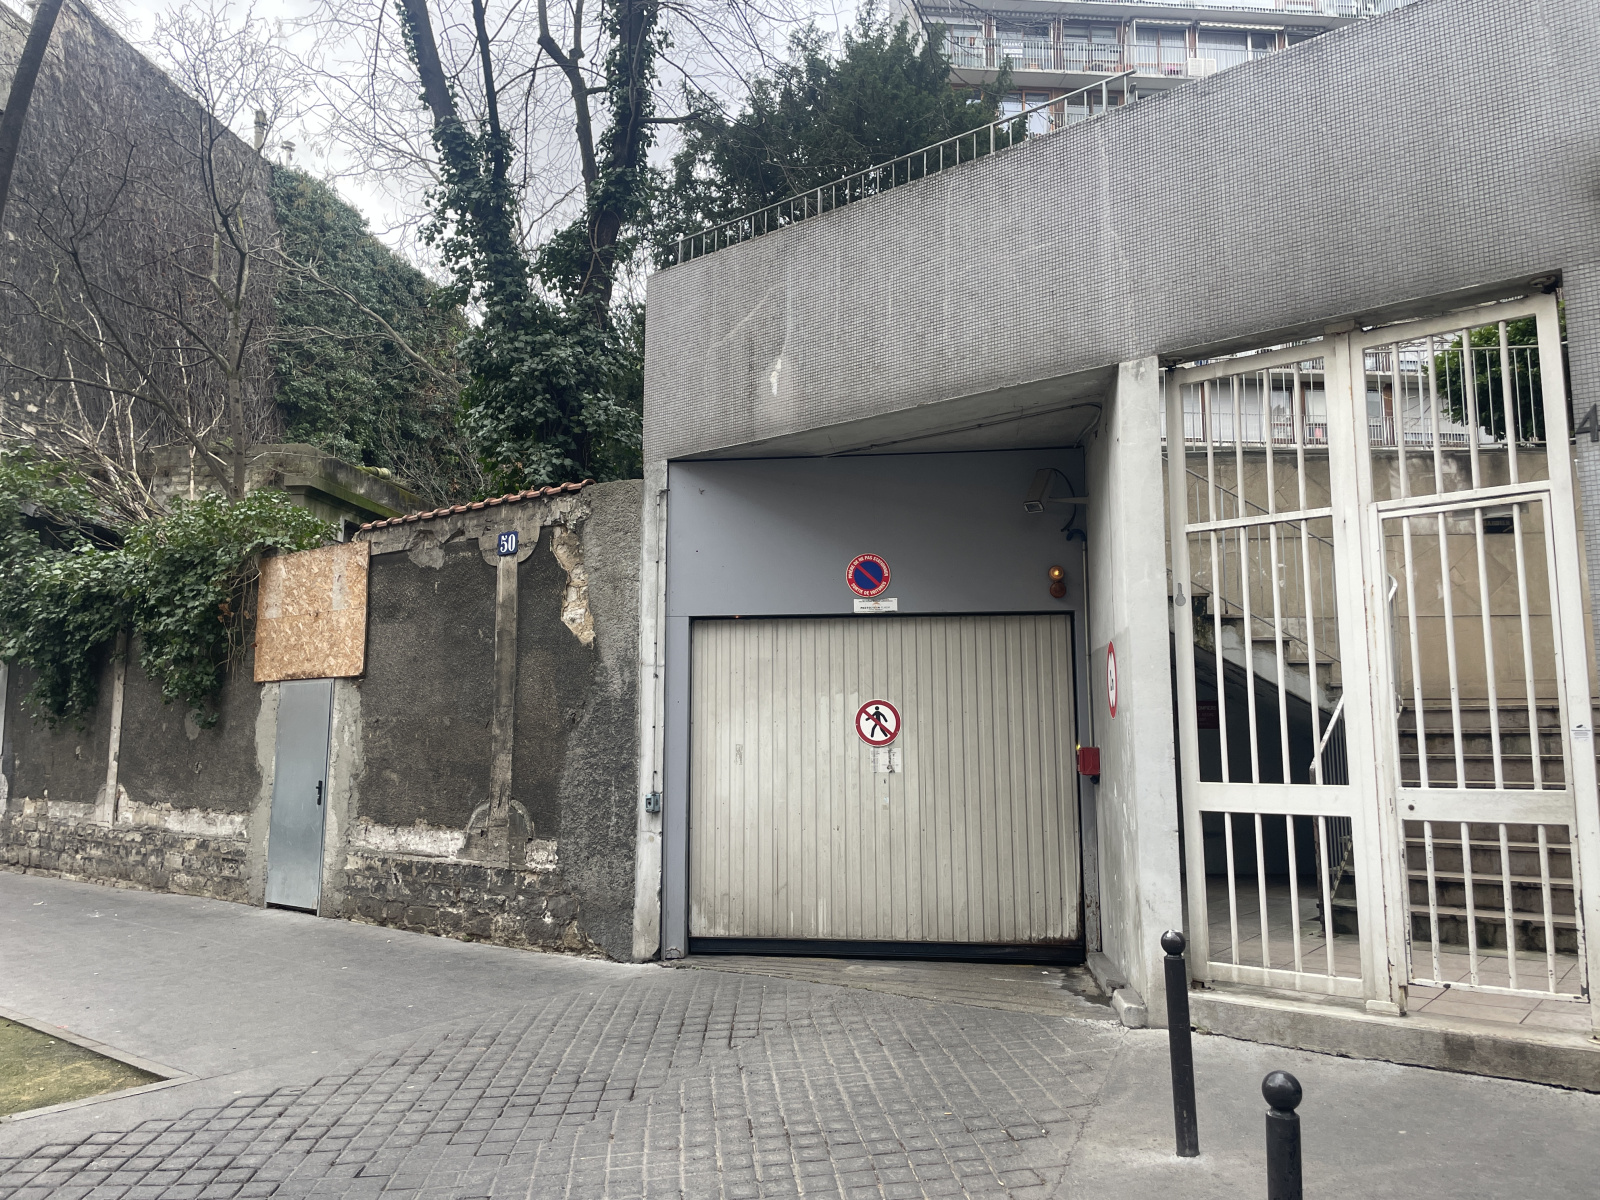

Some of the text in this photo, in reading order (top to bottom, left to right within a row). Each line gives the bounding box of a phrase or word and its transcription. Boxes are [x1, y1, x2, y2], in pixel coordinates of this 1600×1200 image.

[500, 534, 516, 552] 50
[873, 556, 888, 576] STATIONNER
[851, 583, 863, 594] SORTIE
[870, 581, 886, 594] VOITURES
